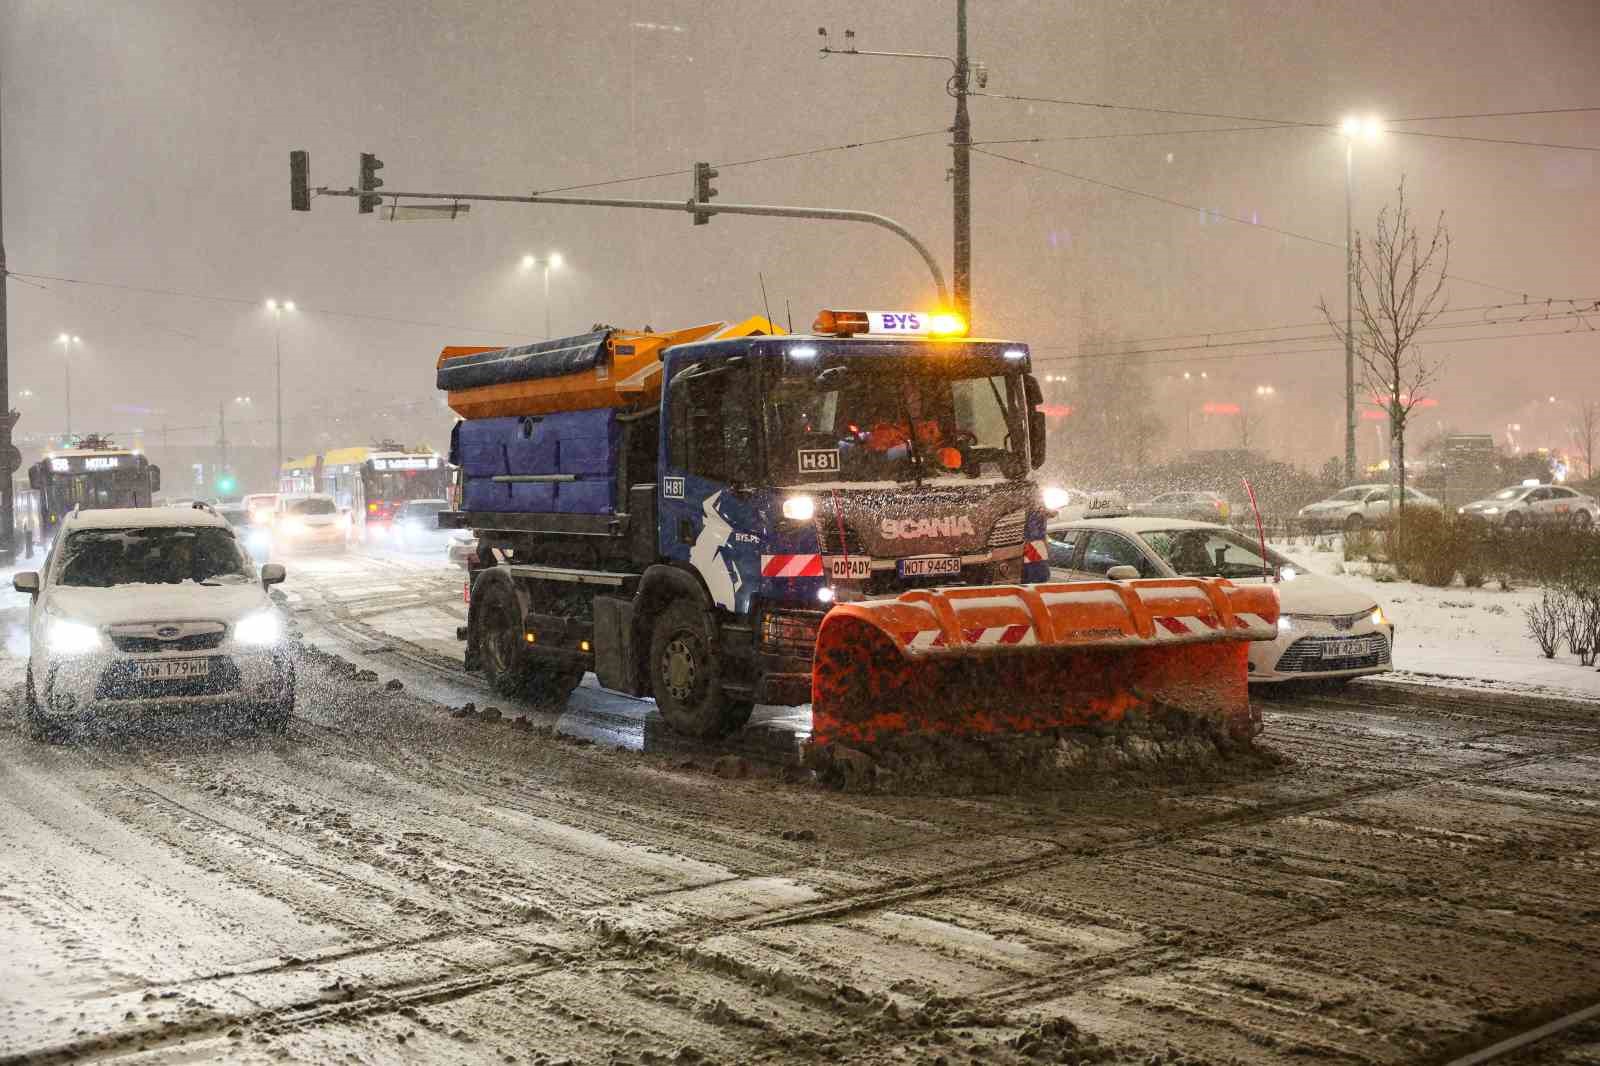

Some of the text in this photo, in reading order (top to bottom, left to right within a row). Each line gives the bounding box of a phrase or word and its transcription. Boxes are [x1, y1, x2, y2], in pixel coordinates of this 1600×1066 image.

[881, 313, 920, 329] BYS
[803, 453, 835, 469] H81
[665, 480, 682, 495] H81
[880, 515, 976, 540] SCANIA
[927, 558, 960, 574] 94458
